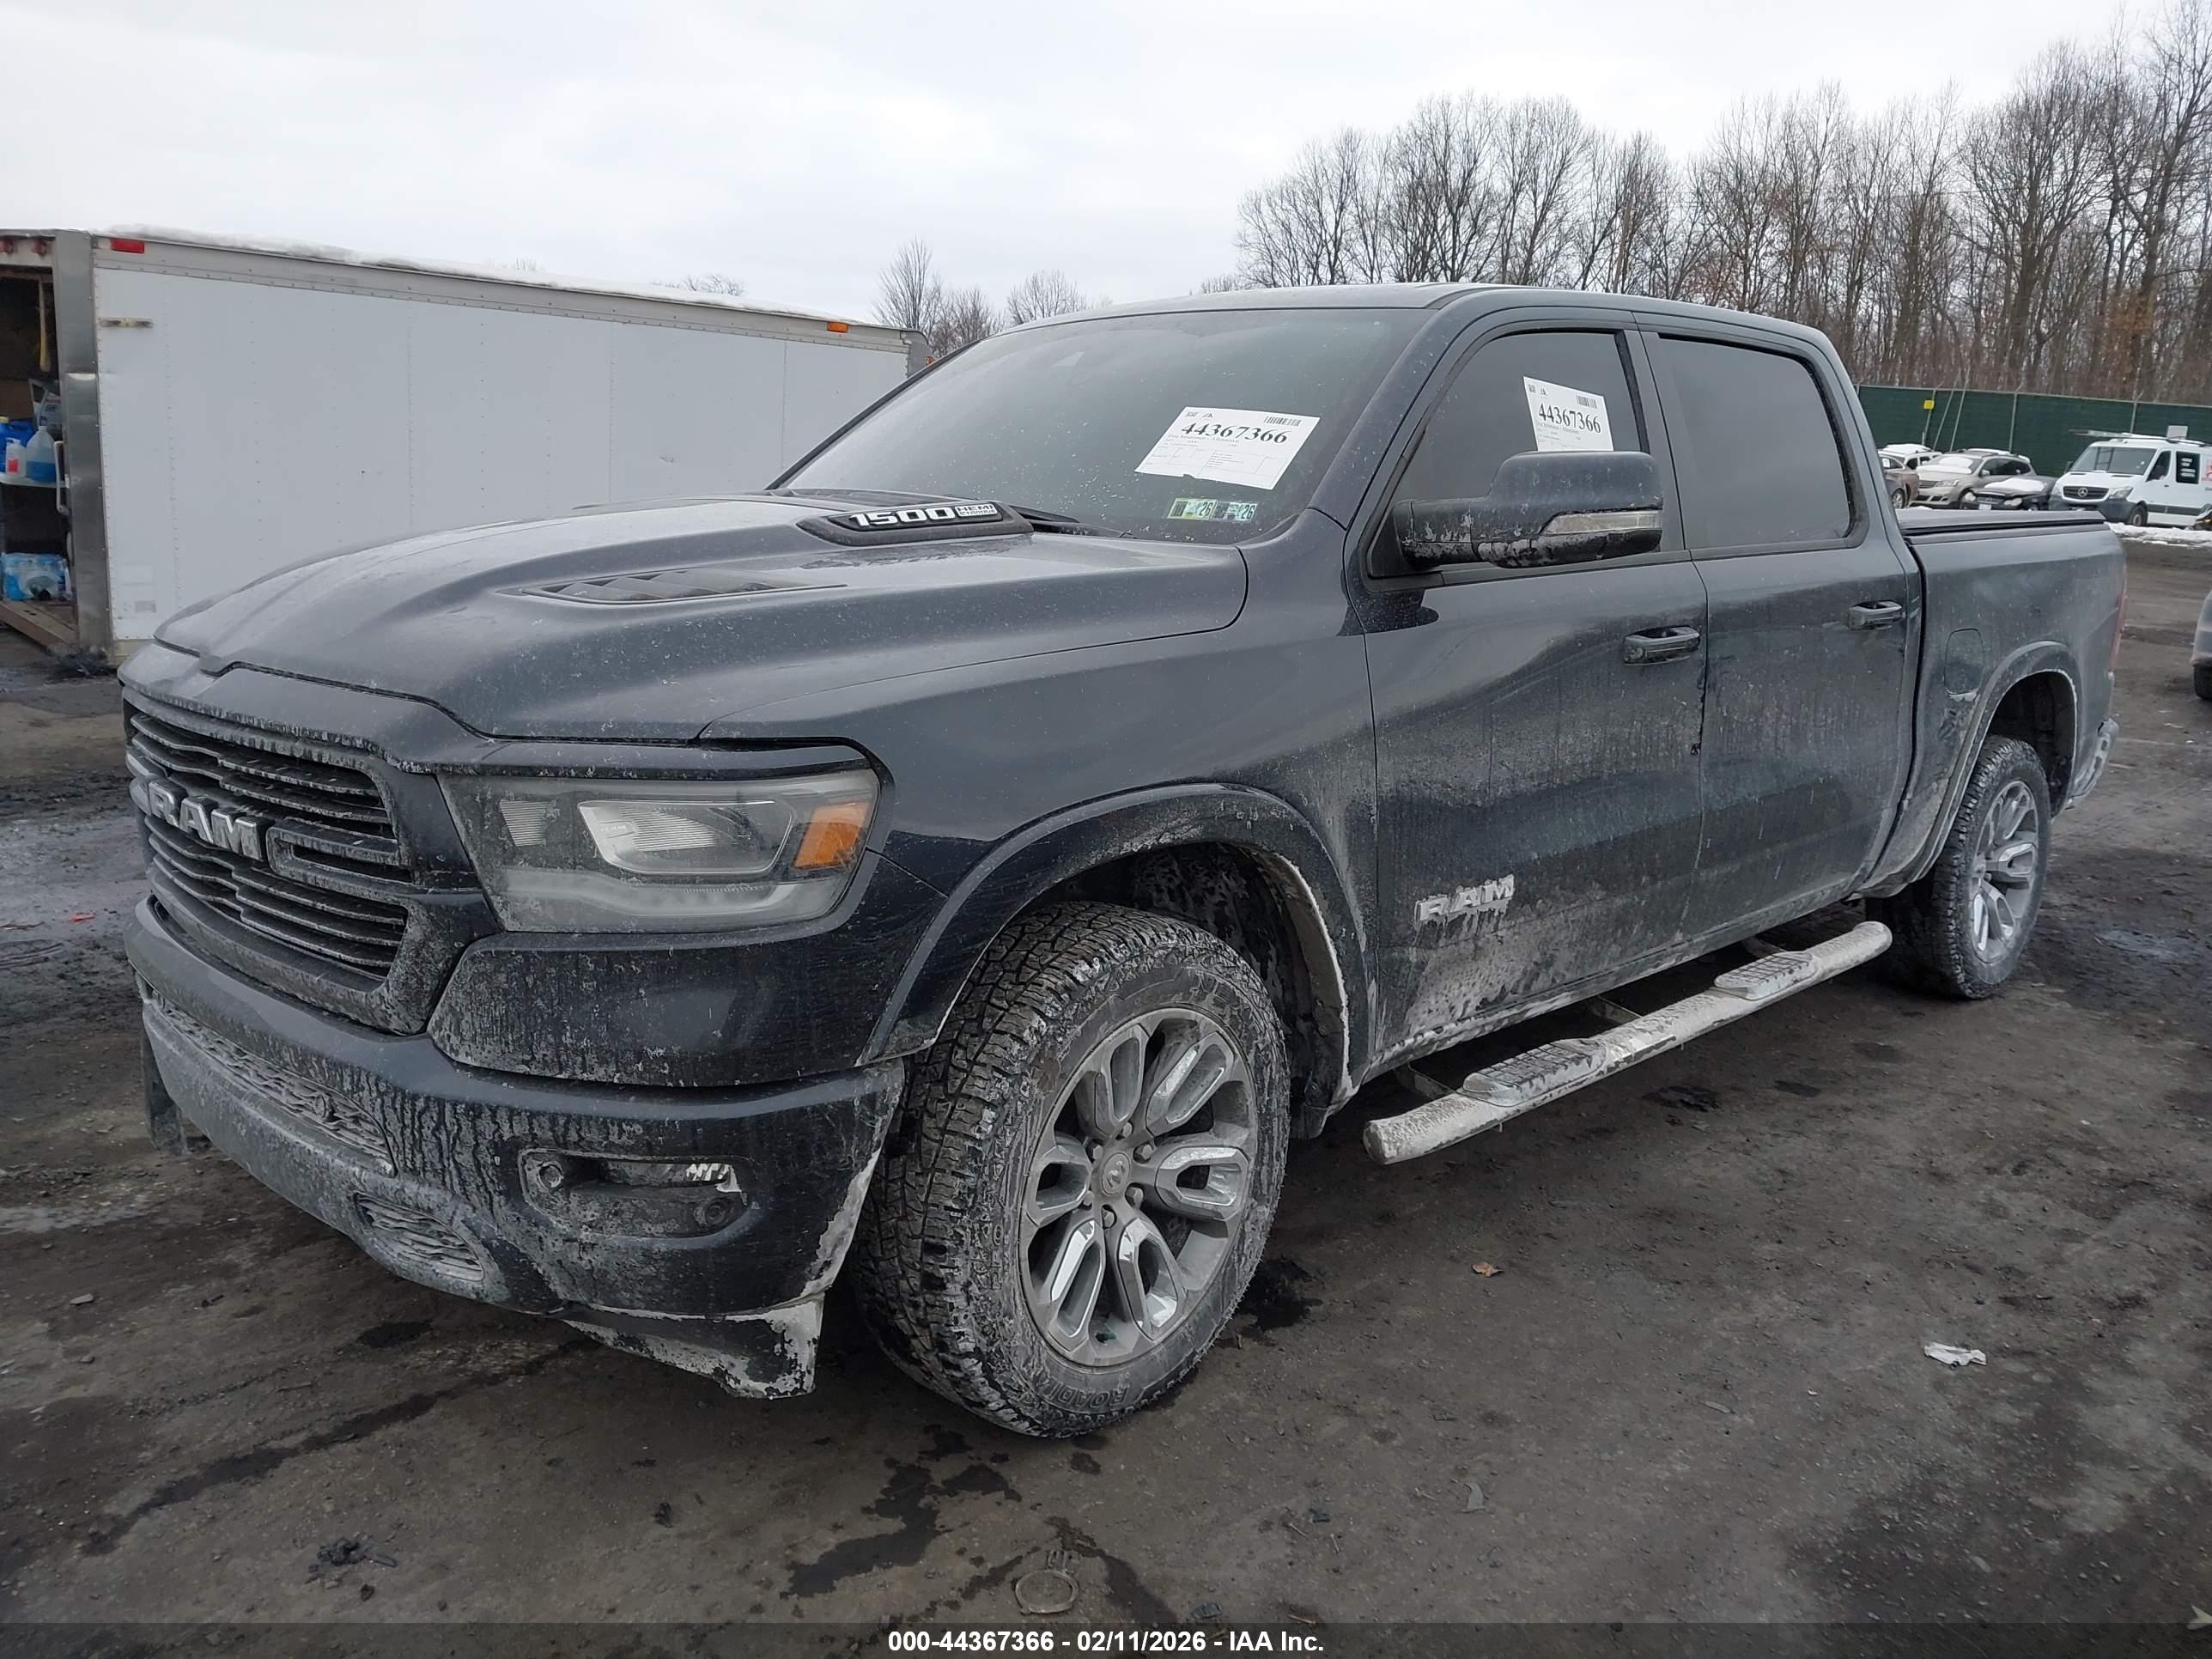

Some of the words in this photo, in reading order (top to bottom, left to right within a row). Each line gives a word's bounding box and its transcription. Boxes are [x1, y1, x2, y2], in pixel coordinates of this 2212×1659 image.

[1538, 403, 1601, 433] 44367366
[1182, 422, 1291, 444] 44367366
[848, 507, 955, 526] 1500
[1199, 501, 1213, 517] 26
[1241, 504, 1255, 520] 26
[148, 776, 266, 860] RAM
[1415, 873, 1515, 921] RAM
